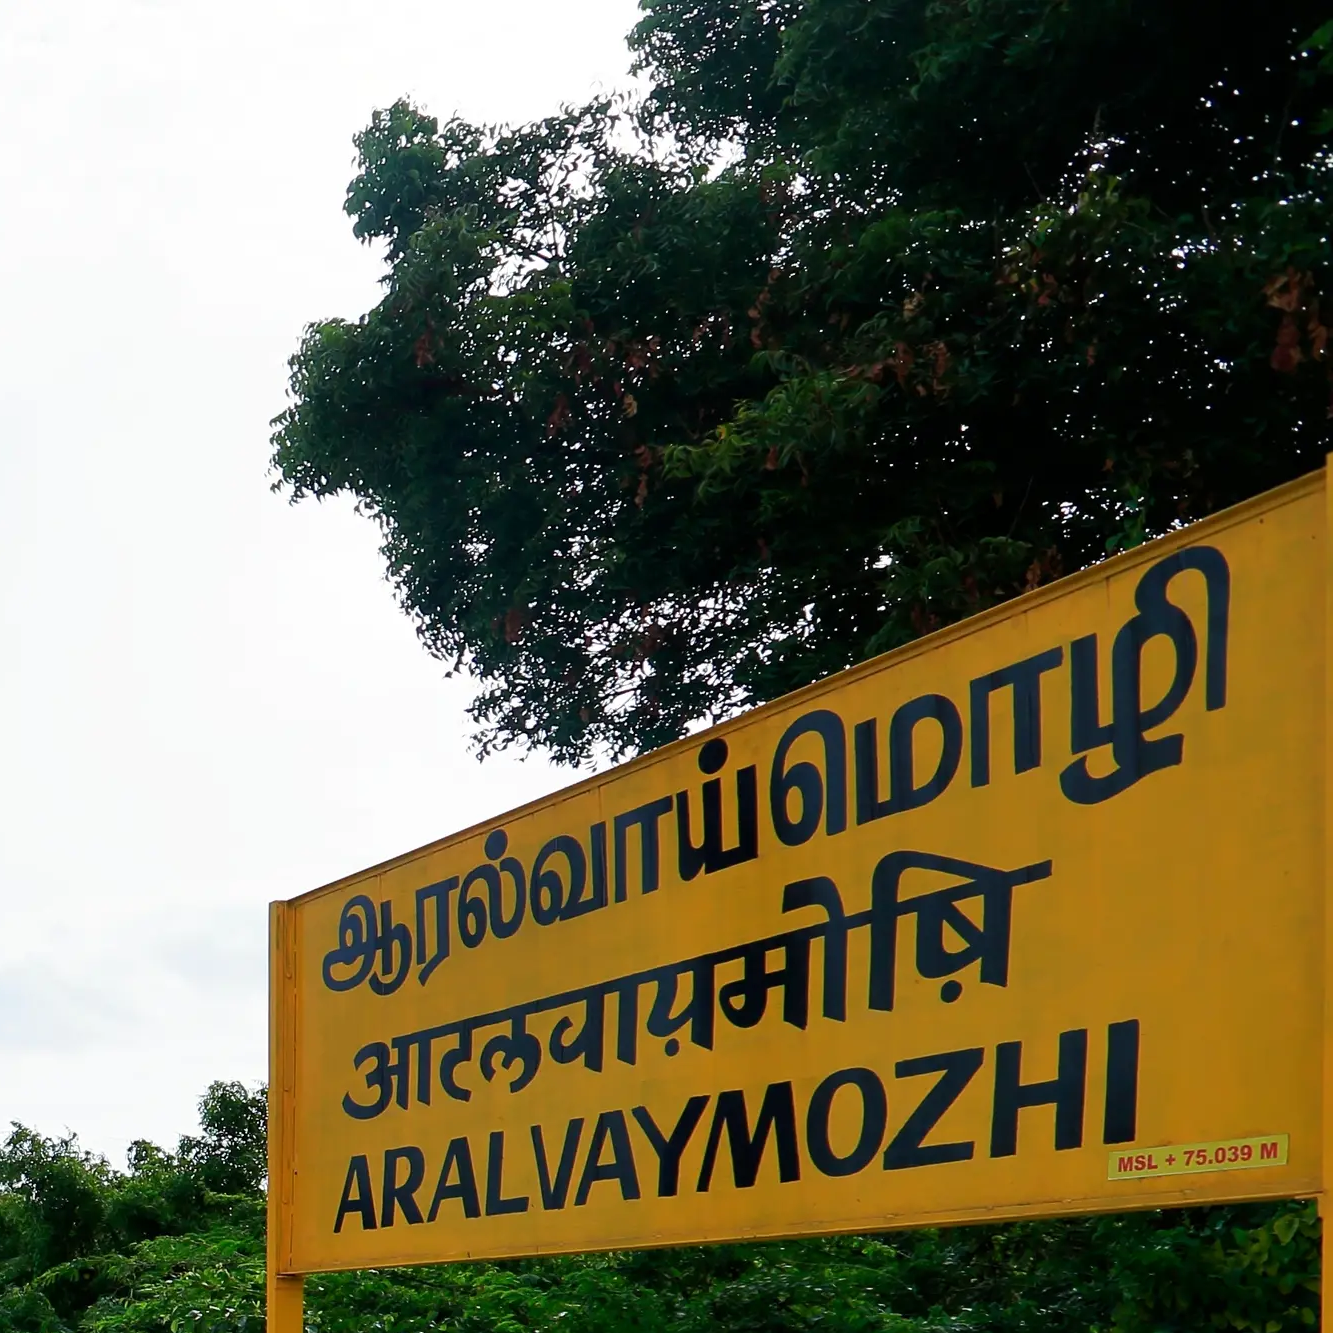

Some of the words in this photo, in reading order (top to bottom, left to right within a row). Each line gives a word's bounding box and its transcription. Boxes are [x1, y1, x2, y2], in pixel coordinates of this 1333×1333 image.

[322, 544, 1230, 996] ஆரல்வாய்மொழி
[333, 1018, 1140, 1234] ARALVAYMOZHI
[1117, 1154, 1158, 1173] MSL
[1165, 1154, 1176, 1166] +
[1183, 1144, 1253, 1167] 75.039
[1260, 1142, 1279, 1160] M
